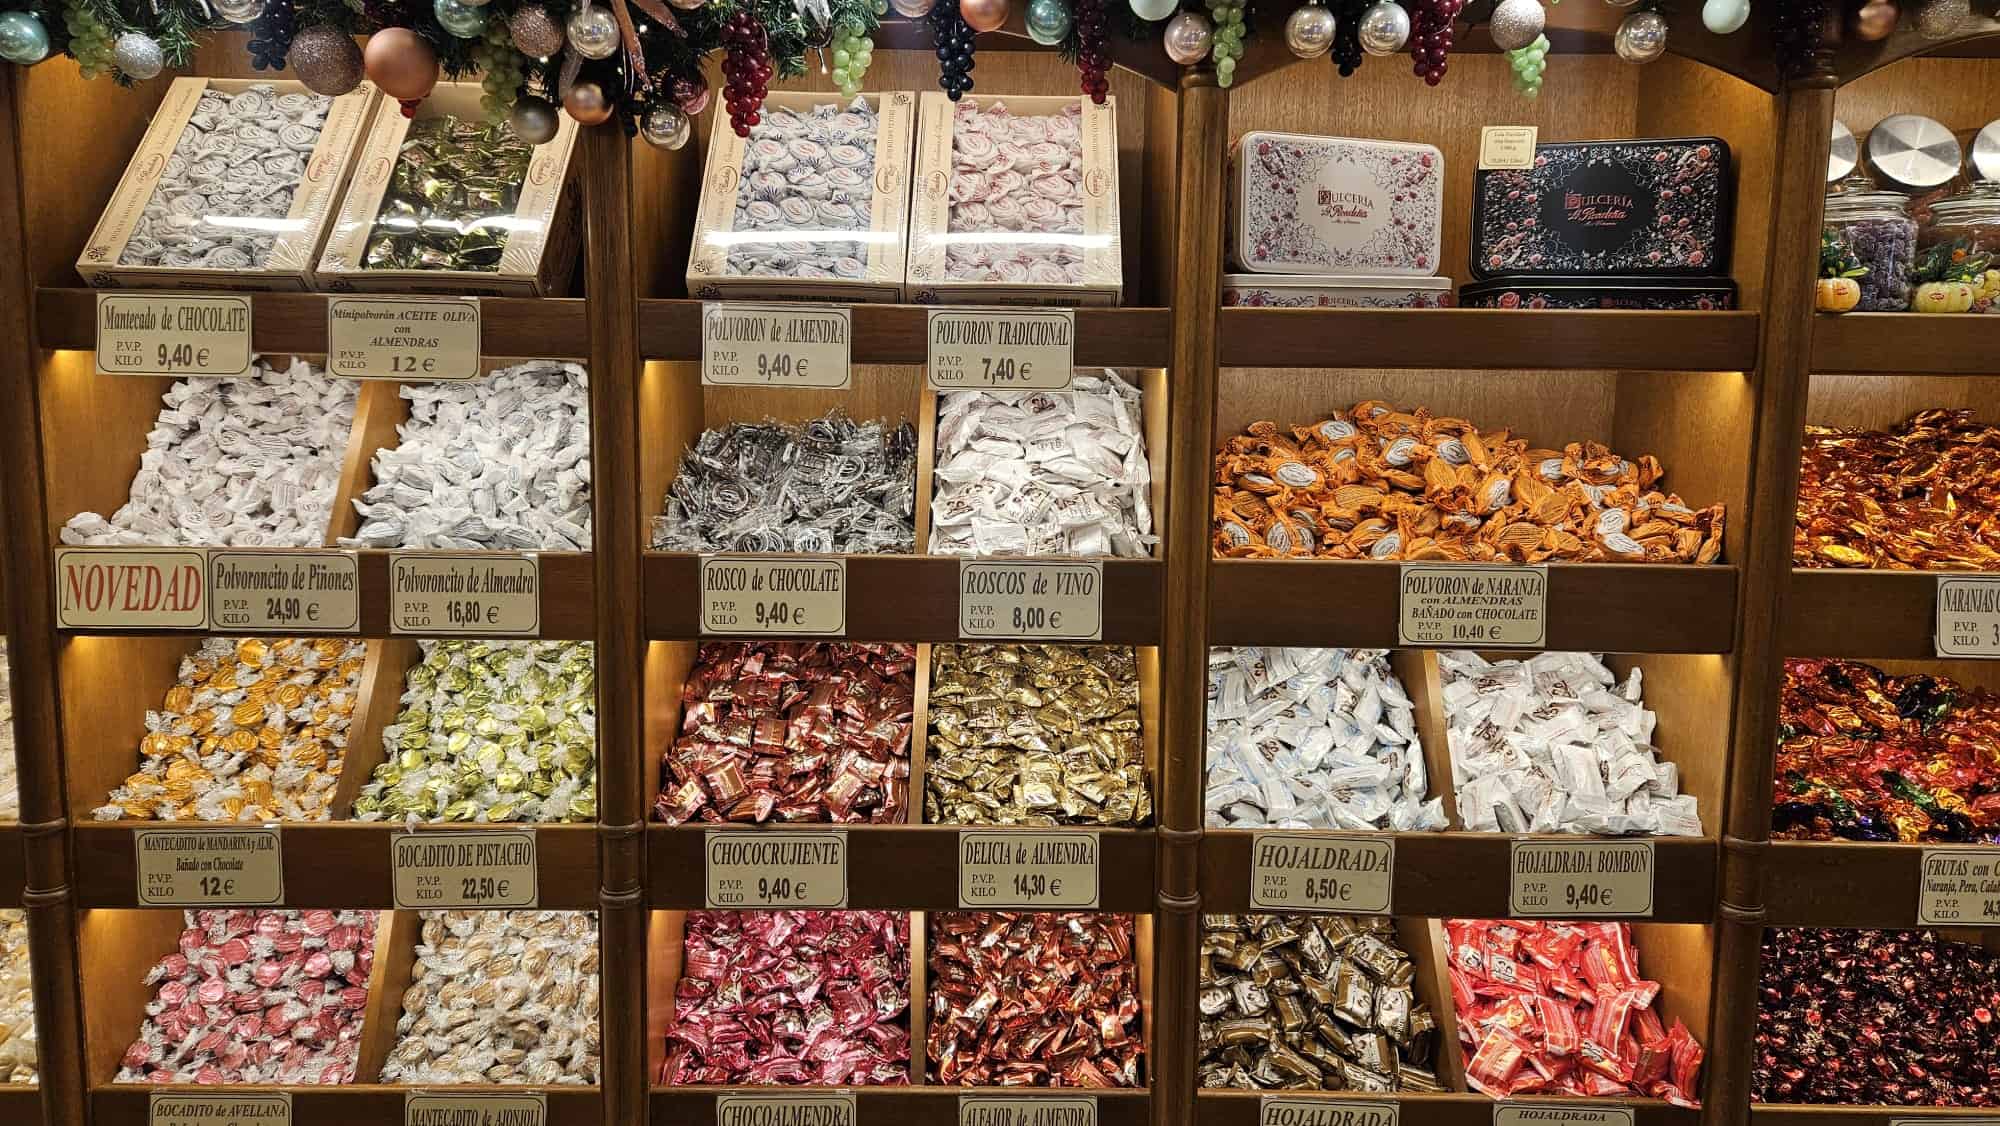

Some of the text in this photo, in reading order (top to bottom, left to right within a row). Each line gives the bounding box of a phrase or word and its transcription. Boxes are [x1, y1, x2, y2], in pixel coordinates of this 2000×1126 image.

[104, 306, 247, 332] Mantecado de CHOCOLATE
[397, 311, 437, 321] ACEITE
[443, 311, 476, 322] OLIVA
[394, 326, 411, 334] con
[771, 318, 781, 343] de
[784, 319, 844, 345] ALMENDRA
[998, 321, 1069, 346] TRADICIONAL
[116, 341, 142, 351] P.V.P.
[370, 338, 440, 348] ALMENDRAS
[115, 355, 143, 366] KILO
[158, 344, 193, 371] 9,40
[340, 351, 367, 359] P.V.P.
[713, 352, 738, 362] P.V.P.
[937, 355, 963, 367] P.V.P.
[338, 360, 367, 369] KILO
[392, 356, 417, 372] 12
[758, 353, 791, 380] 9,40
[712, 365, 739, 376] KILO
[937, 369, 964, 381] KILO
[981, 358, 1015, 385] 7,40
[216, 563, 289, 590] Polvoroncito
[291, 564, 305, 590] de
[397, 566, 534, 594] Polvoroncito de Almendra
[707, 567, 840, 592] ROSCO de CHOCOLATE
[63, 564, 201, 612] NOVEDAD
[966, 571, 1094, 596] ROSCOS de VINO
[1472, 577, 1484, 595] de
[1487, 577, 1542, 596] NARANJA
[223, 600, 249, 610] P.V.P.
[712, 601, 736, 611] P.V.P.
[1443, 596, 1524, 606] ALMENDRAS
[1943, 588, 1994, 612] NARANJAS
[266, 598, 300, 624] 24,90
[404, 602, 429, 613] P.V.P.
[969, 606, 994, 616] P.V.P.
[1412, 605, 1538, 620] BAÑADO con CHOCOLATE
[223, 614, 250, 624] KILO
[446, 601, 480, 628] 16,80
[711, 615, 738, 625] KILO
[756, 602, 788, 629] 9,40
[1013, 607, 1045, 633] 8,00
[403, 616, 431, 627] KILO
[969, 619, 995, 630] KILO
[1418, 622, 1442, 630] P.V.P.
[1953, 621, 1978, 632] P.V.P.
[1417, 632, 1443, 641] KILO
[1953, 635, 1980, 646] KILO
[144, 836, 197, 851] MANTECADITO
[198, 837, 206, 851] de
[207, 836, 250, 851] MANDARINA
[399, 842, 531, 868] BOCADITO DE PISTACHO
[712, 842, 840, 865] CHOCOCRUJIENTE
[965, 842, 1094, 865] DELICIA de ALMENDRA
[1258, 845, 1389, 873] HOJALDRADA
[201, 861, 212, 871] con
[213, 857, 244, 871] Chocolate
[1517, 850, 1649, 874] HOJALDRADA BOMBON
[1927, 859, 1969, 876] FRUTAS
[1972, 864, 1990, 876] con
[148, 873, 172, 883] P.V.P.
[417, 876, 441, 887] P.V.P.
[972, 873, 995, 884] P.V.P.
[1264, 875, 1288, 886] P.V.P.
[200, 876, 221, 897] 12
[462, 878, 494, 904] 22,50
[719, 880, 743, 890] P.V.P.
[758, 878, 790, 904] 9,40
[1014, 874, 1046, 901] 14,30
[1305, 878, 1338, 904] 8,50
[1523, 883, 1547, 893] P.V.P.
[147, 887, 175, 897] KILO
[416, 889, 443, 900] KILO
[719, 893, 744, 903] KILO
[971, 887, 996, 897] KILO
[1262, 889, 1288, 899] KILO
[1566, 884, 1598, 910] 9,40
[1522, 896, 1548, 906] KILO
[1936, 899, 1960, 908] P.V.P.
[1934, 910, 1960, 919] KILO
[156, 1104, 286, 1118] BOCADITO de AVELLANA
[411, 1109, 479, 1126] MANTECADITO
[482, 1108, 493, 1126] de
[722, 1105, 851, 1126] CHOCOALMENDRA
[966, 1107, 1091, 1126] ALFAJOR de ALMENDRA
[1265, 1107, 1393, 1126] HOJALDRADA
[1519, 1110, 1606, 1122] HOJALDRADA
